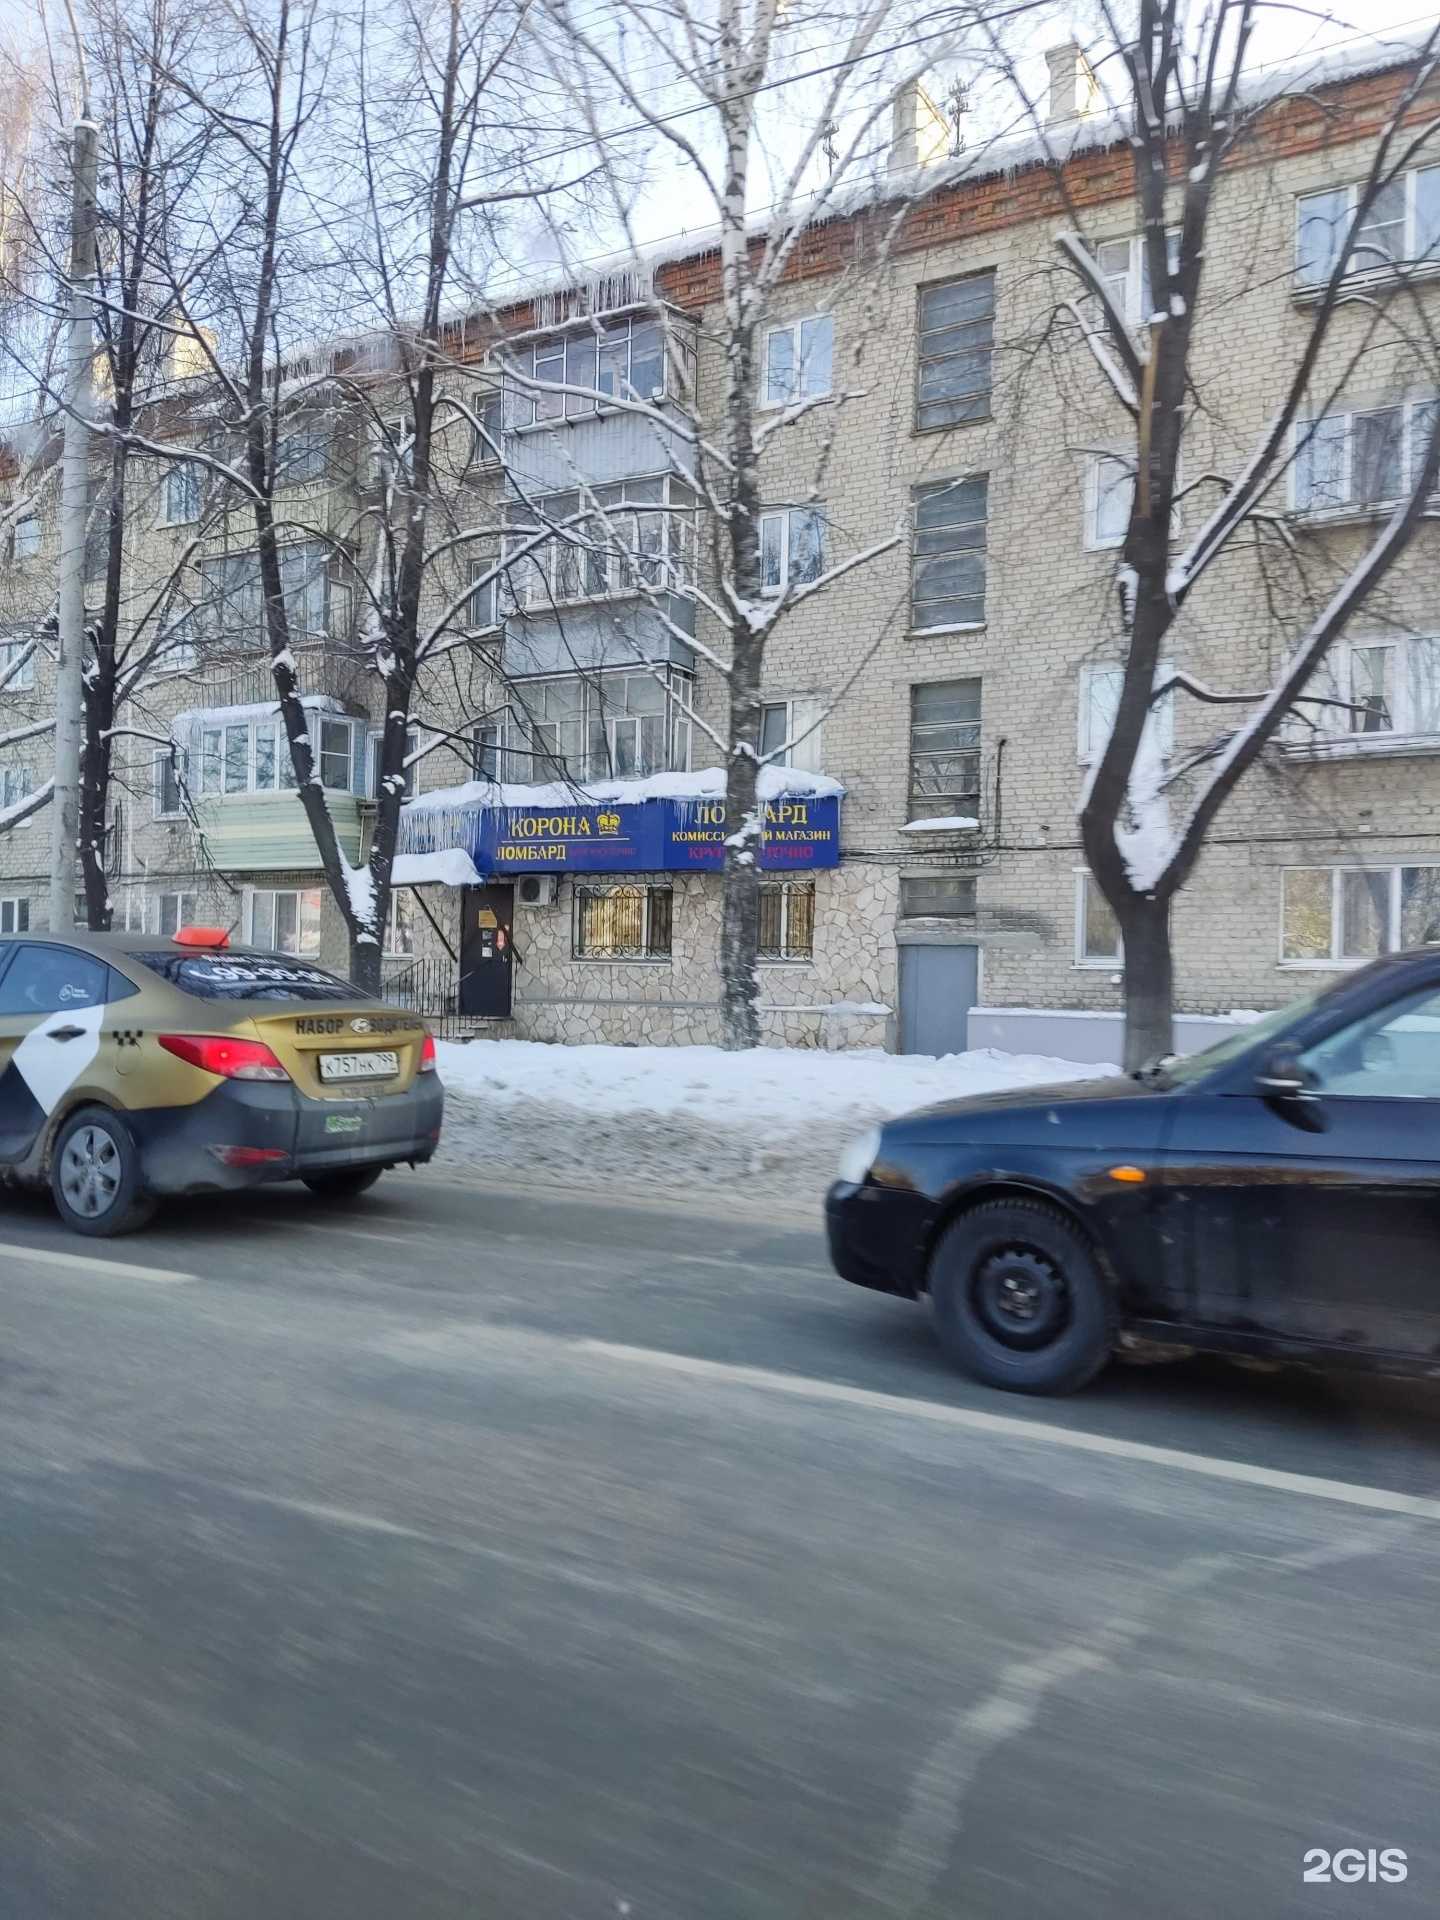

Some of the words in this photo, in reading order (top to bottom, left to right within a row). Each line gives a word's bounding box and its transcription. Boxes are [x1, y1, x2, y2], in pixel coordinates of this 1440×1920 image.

[694, 805, 808, 824] ЛОАРД
[511, 816, 592, 837] КОРОНА
[776, 830, 831, 841] МАГАЗИН
[496, 845, 566, 861] ЛОМБАРД
[296, 1019, 344, 1034] НАБОР
